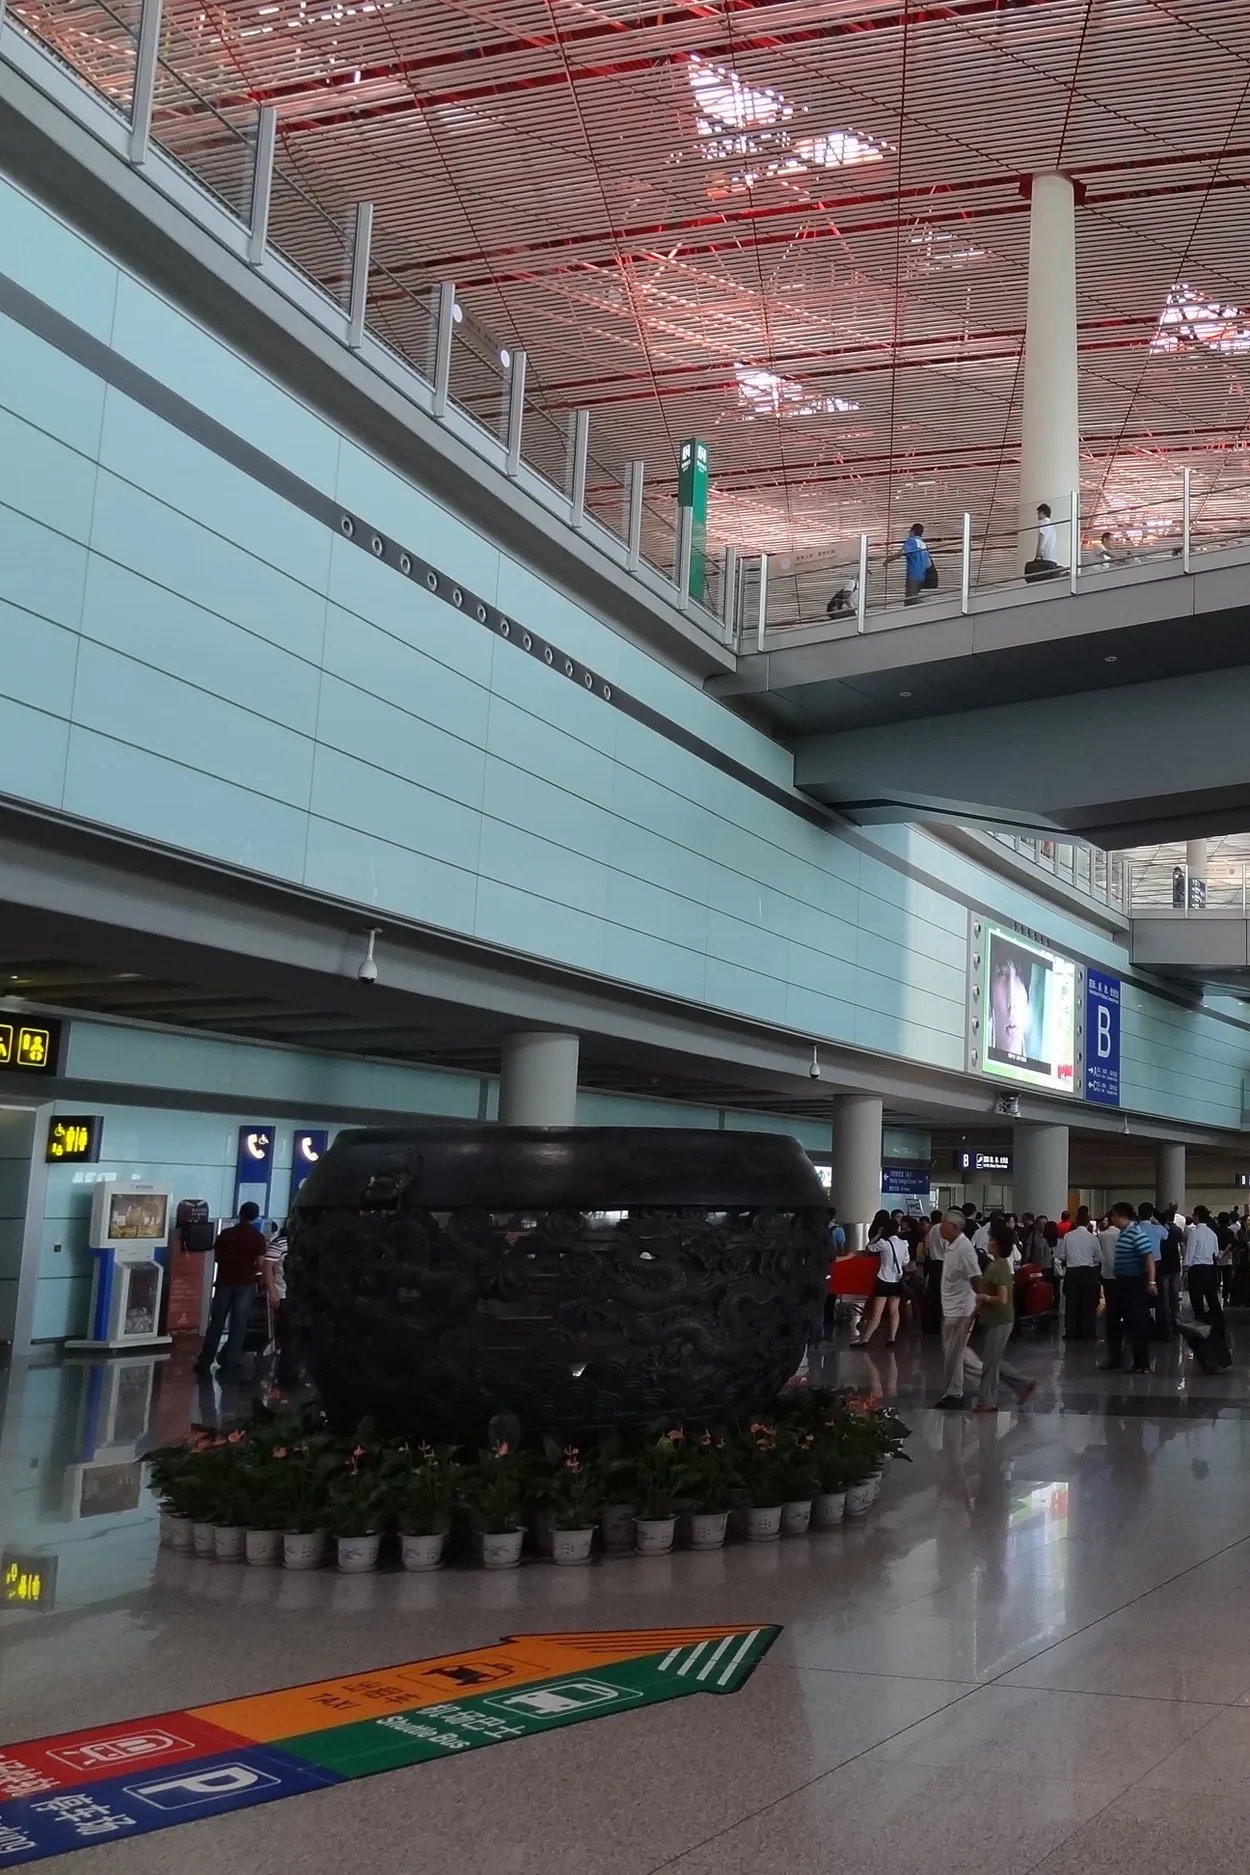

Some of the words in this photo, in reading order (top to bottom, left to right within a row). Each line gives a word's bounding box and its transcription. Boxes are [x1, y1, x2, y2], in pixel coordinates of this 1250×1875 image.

[1098, 1004, 1111, 1058] B
[963, 1154, 969, 1167] B
[307, 1692, 363, 1711] TAXI
[341, 1680, 422, 1704] 出租车
[375, 1715, 438, 1739] Shuttle
[428, 1732, 472, 1750] Bus
[416, 1703, 526, 1738] 机场巴士
[29, 1793, 138, 1836] 停车场
